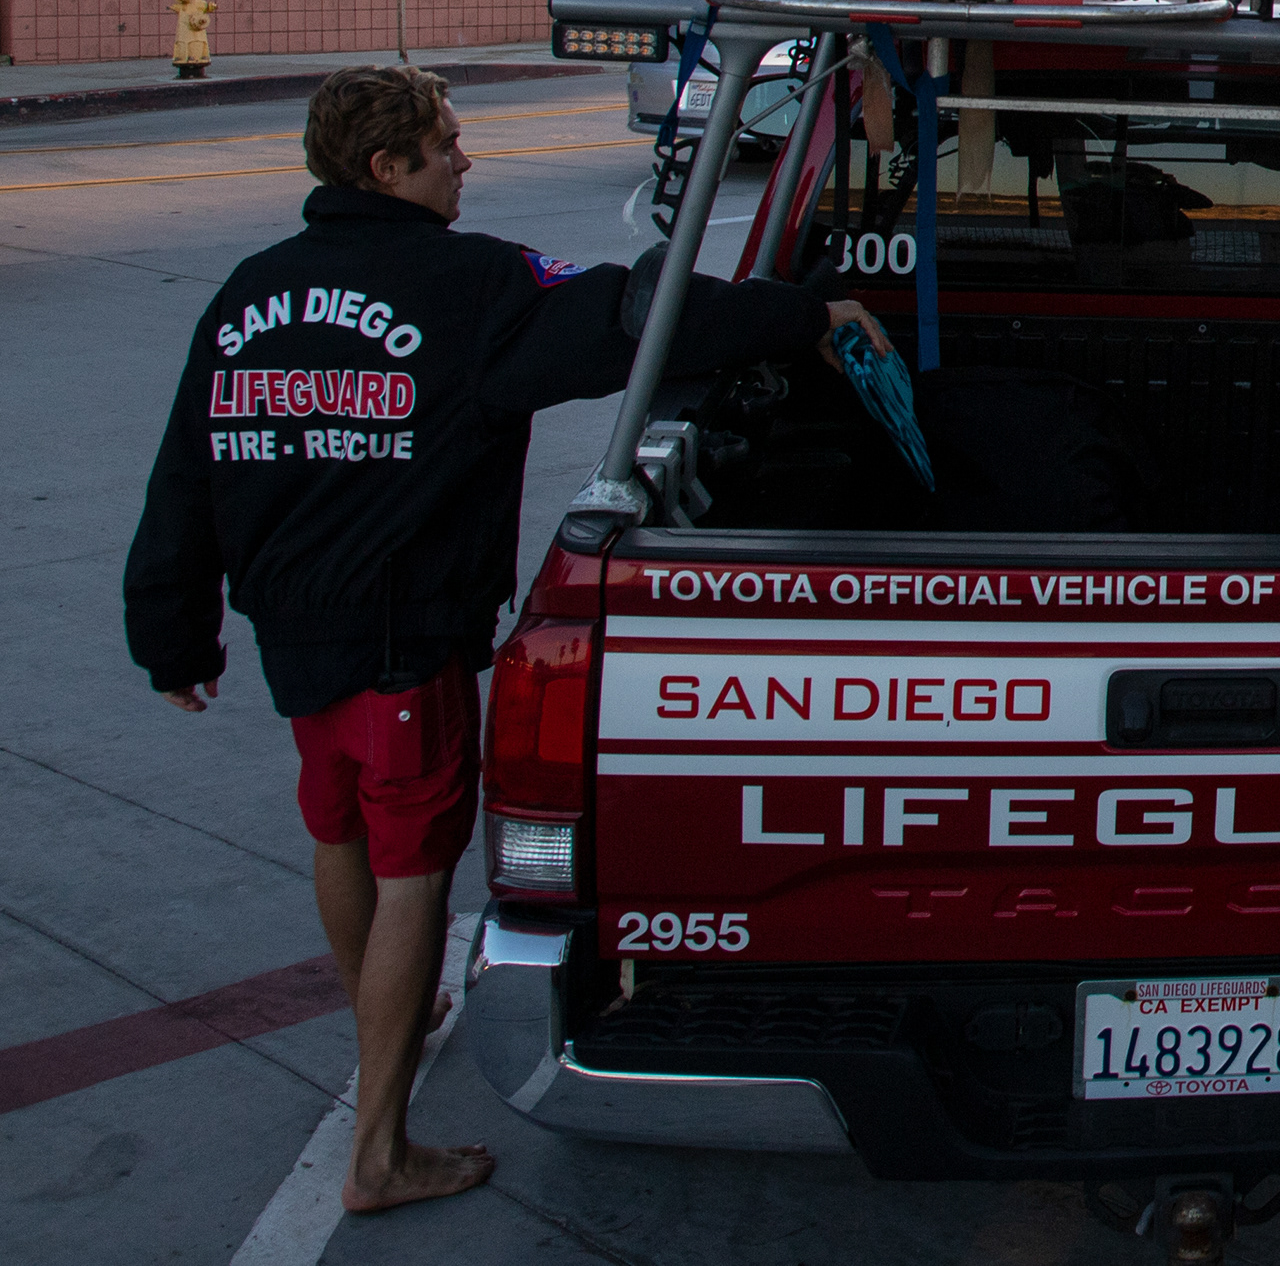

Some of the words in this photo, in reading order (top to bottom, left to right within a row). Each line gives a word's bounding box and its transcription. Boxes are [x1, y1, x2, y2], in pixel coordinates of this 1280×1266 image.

[217, 290, 291, 357] SAN
[302, 287, 422, 358] DIEGO
[209, 369, 416, 420] LIFEGUARD
[210, 430, 276, 461] FIRE
[303, 428, 414, 462] RESCUE
[643, 569, 818, 604] TOYOTA
[829, 573, 1022, 606] OFFICIAL
[1029, 575, 1207, 606] VEHICLE
[1219, 574, 1276, 606] OF
[655, 674, 812, 721] SAN
[833, 676, 1051, 722] DIEGO
[617, 911, 751, 952] 2955
[1138, 983, 1160, 998] SAN
[1162, 982, 1197, 997] DIEGO
[1200, 980, 1267, 996] LIFEGUARDS
[1138, 999, 1168, 1015] CA
[1179, 996, 1264, 1013] EXEMPT
[1174, 1078, 1250, 1094] TOYOTA
